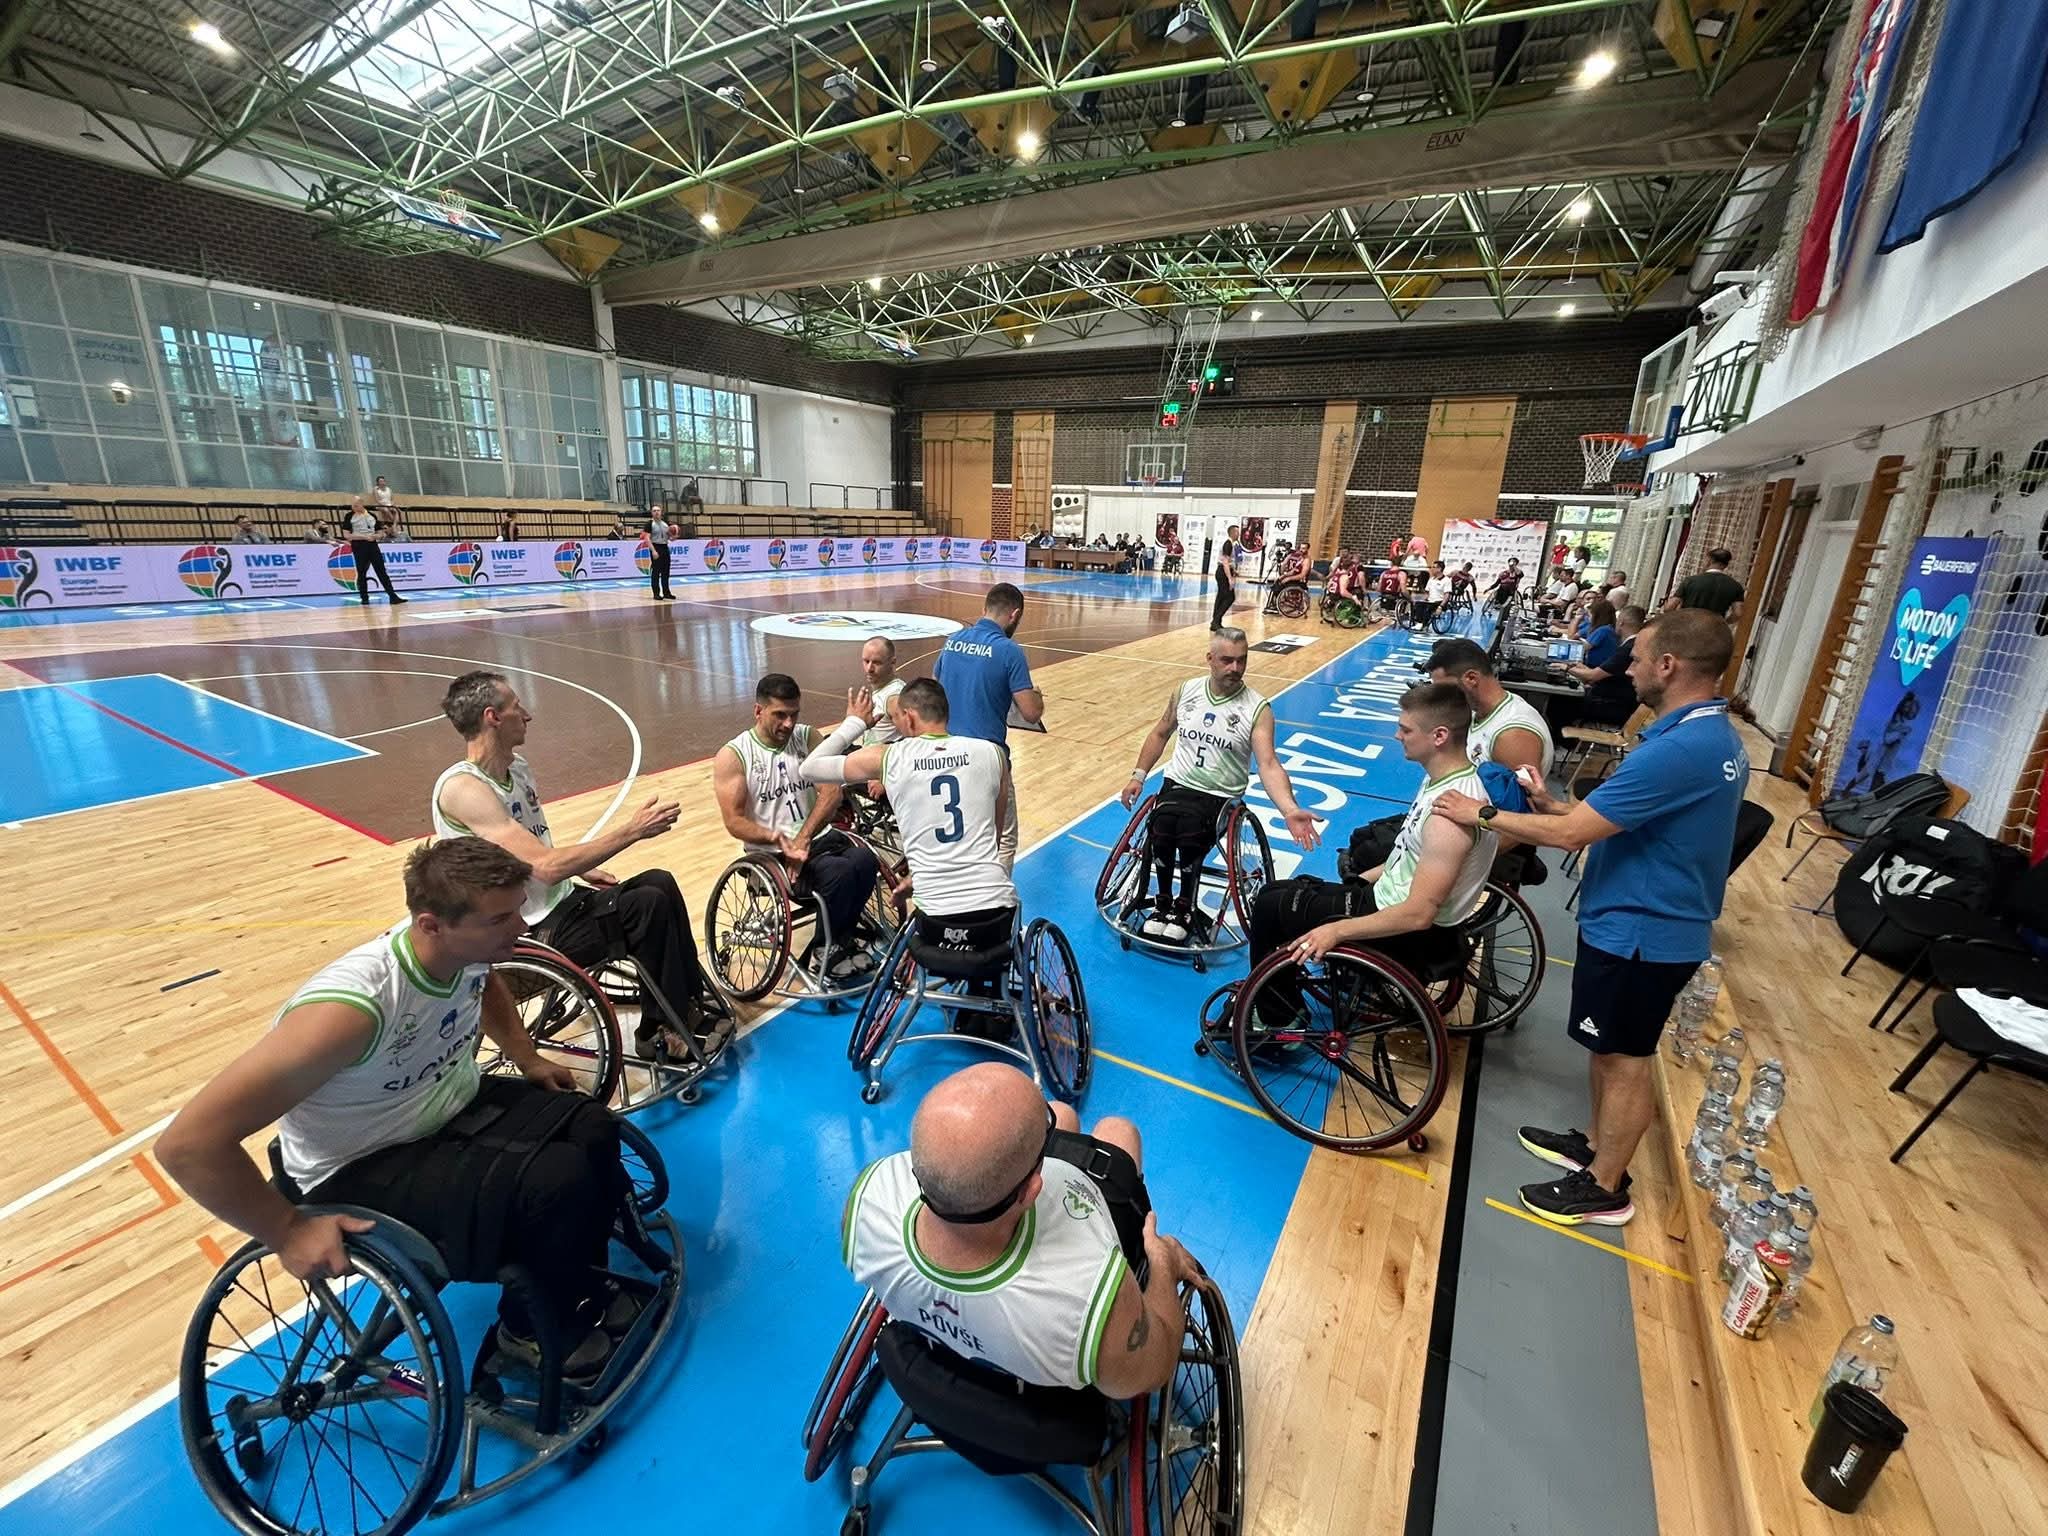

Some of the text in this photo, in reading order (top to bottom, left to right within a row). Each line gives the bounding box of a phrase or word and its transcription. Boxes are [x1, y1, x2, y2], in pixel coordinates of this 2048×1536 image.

[1427, 131, 1465, 148] ELAN
[1275, 520, 1292, 530] RGK
[491, 549, 526, 560] IWBF
[590, 548, 618, 557] IWBF
[669, 546, 689, 555] WBF
[729, 545, 751, 553] IWBF
[790, 544, 808, 552] IWBF
[55, 557, 121, 572] IWBF
[245, 554, 297, 567] IWBF
[1932, 560, 1977, 574] BAUERFEIND
[61, 578, 97, 586] Europe
[1900, 607, 1957, 639] MOTION
[944, 639, 993, 657] SLOVENIA
[1890, 636, 1938, 669] IS LIFE
[1178, 727, 1234, 750] SLOVENIA
[1195, 746, 1207, 768] 5
[786, 799, 805, 822] 11
[931, 774, 965, 843] 3
[943, 927, 969, 943] RGK
[1733, 1284, 1760, 1329] CARNITINE
[918, 1307, 986, 1354] POVŠE
